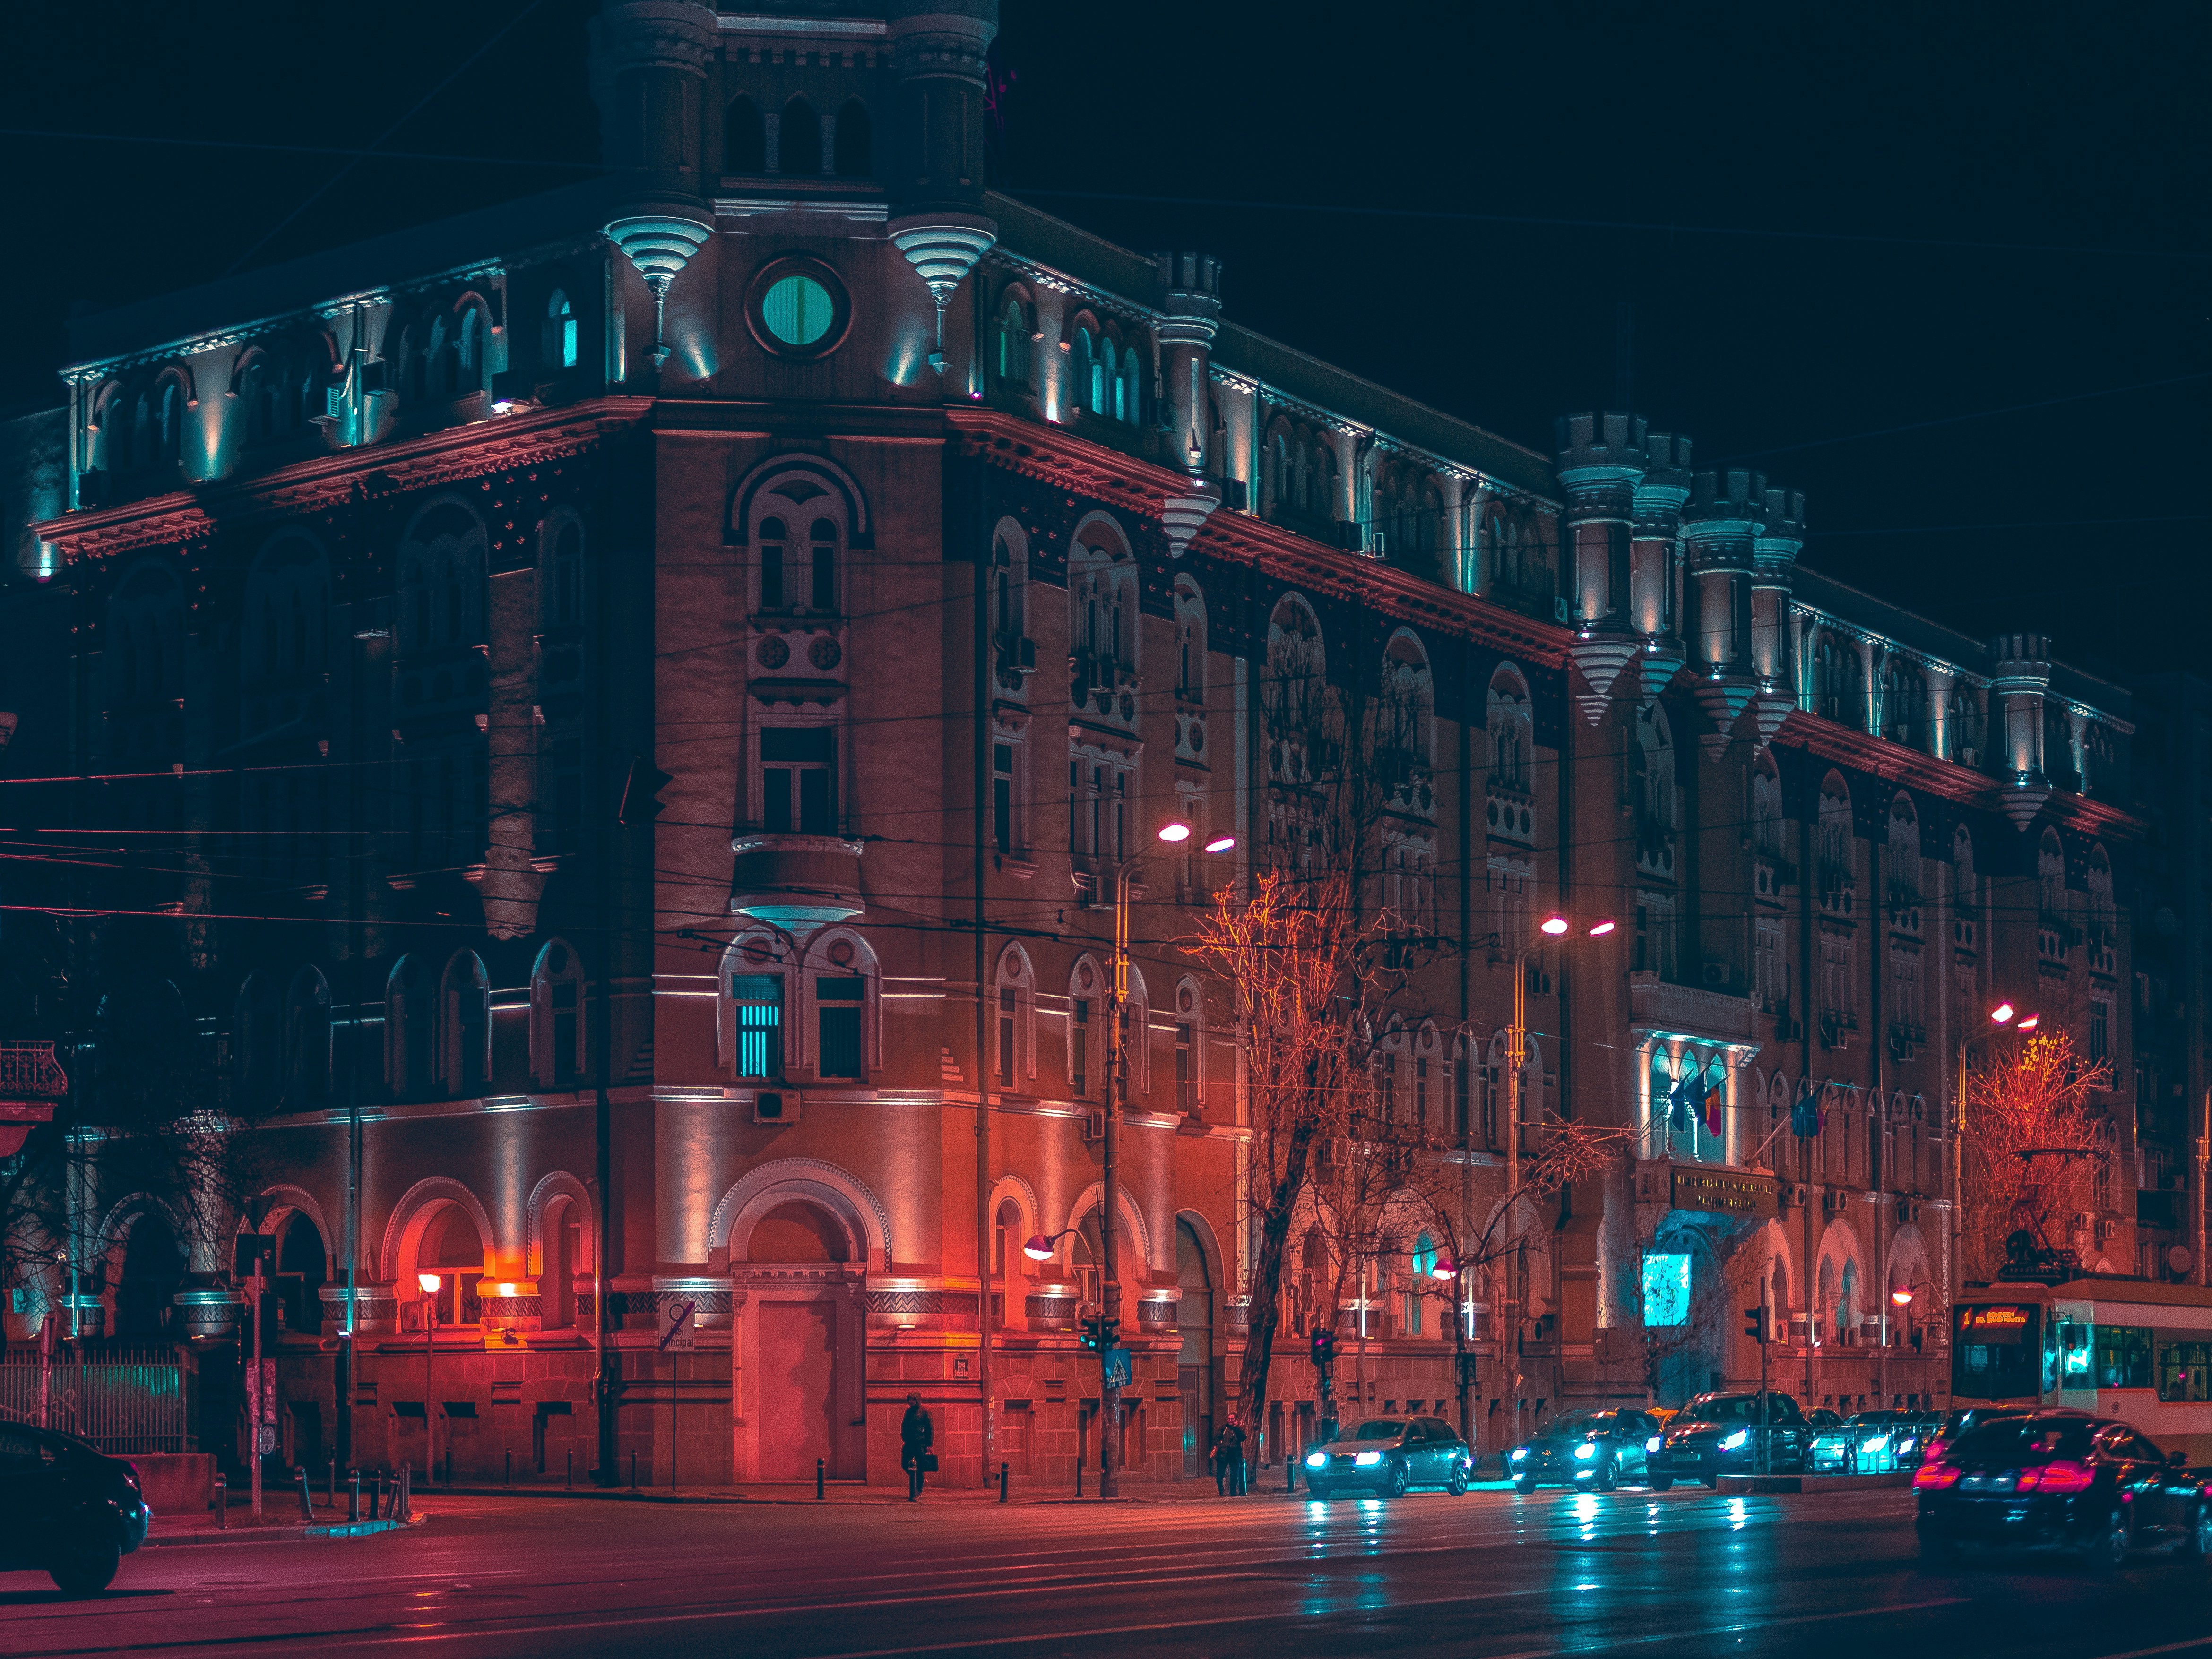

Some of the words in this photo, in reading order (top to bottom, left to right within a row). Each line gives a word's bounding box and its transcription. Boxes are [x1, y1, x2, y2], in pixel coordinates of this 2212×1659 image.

[1964, 1312, 1970, 1324] 1
[670, 1325, 684, 1336] el
[660, 1336, 694, 1350] Pncipal
